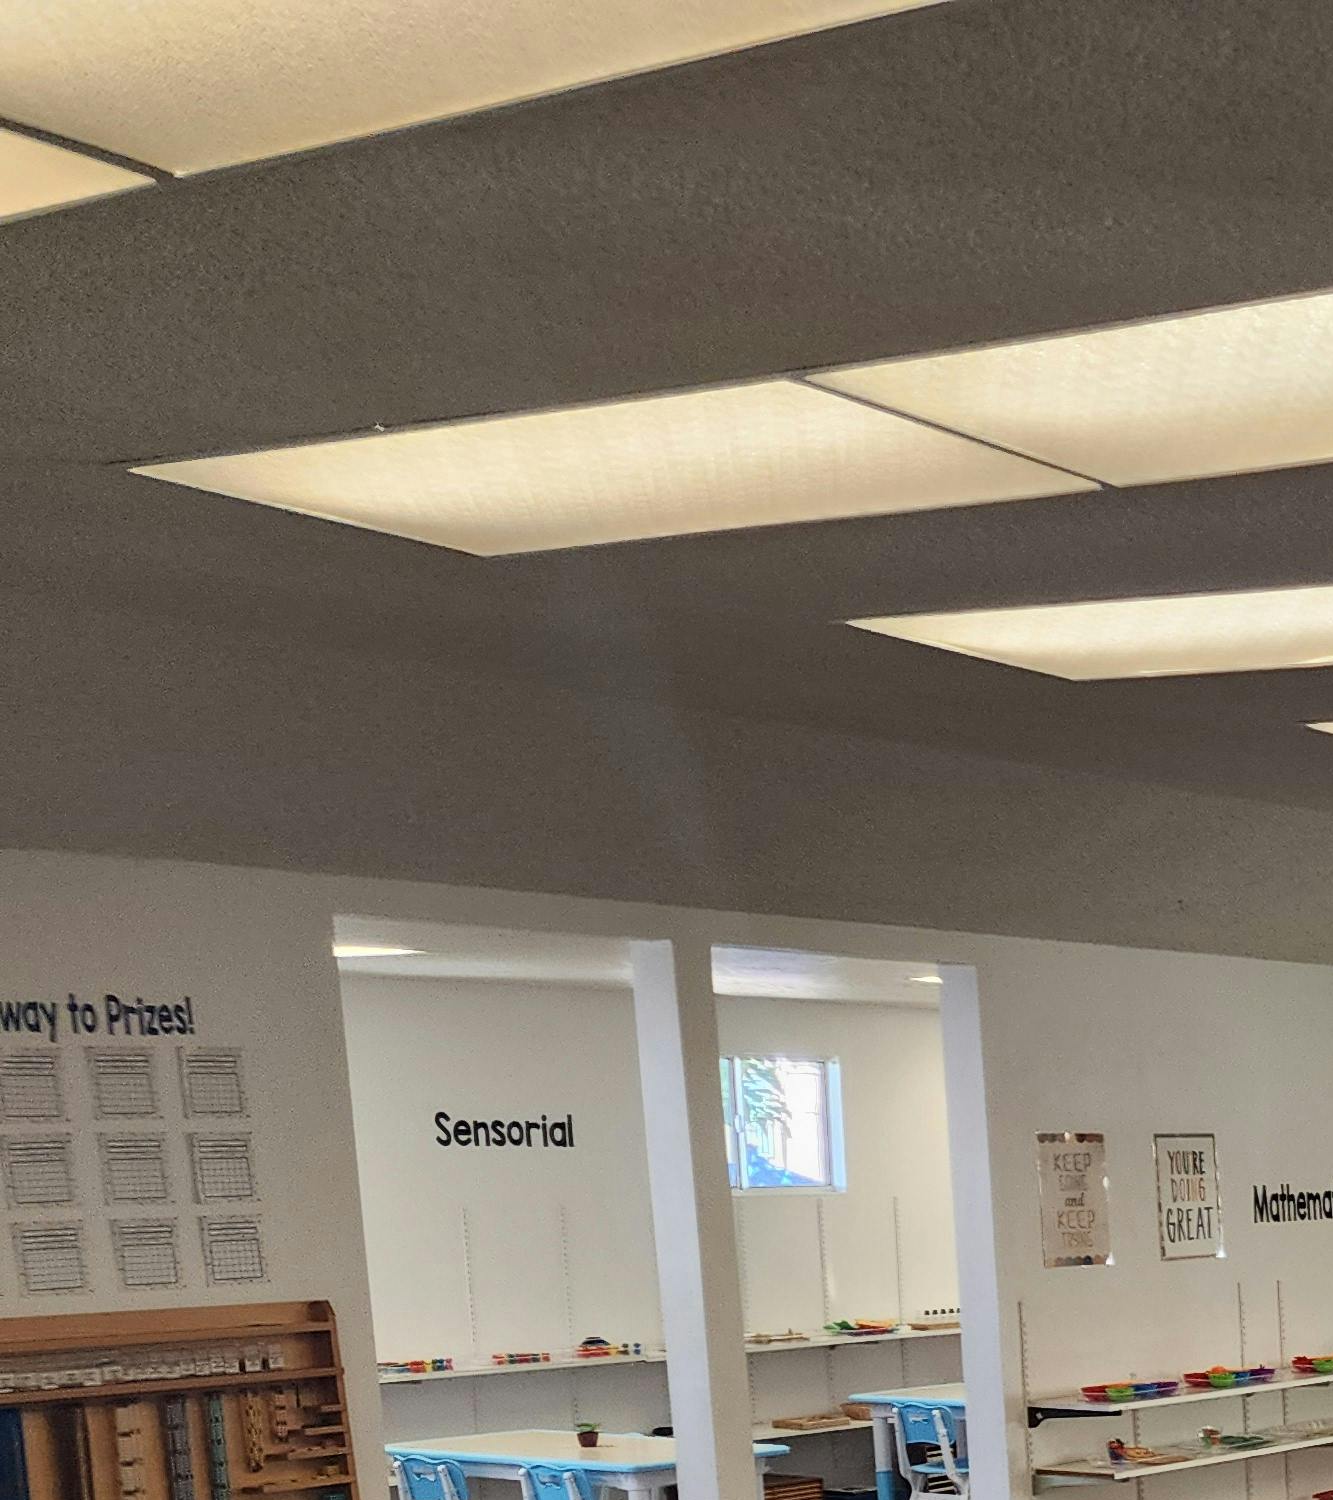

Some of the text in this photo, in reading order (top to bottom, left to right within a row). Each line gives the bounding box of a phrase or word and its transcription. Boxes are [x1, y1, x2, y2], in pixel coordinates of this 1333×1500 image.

[0, 993, 195, 1042] way to Prizes!
[435, 1112, 574, 1148] Sensorial
[1053, 1153, 1091, 1172] KEEP
[1167, 1150, 1207, 1175] YOU'RE
[1065, 1192, 1085, 1207] and
[1170, 1178, 1207, 1203] DOING
[1166, 1207, 1213, 1243] GREAT
